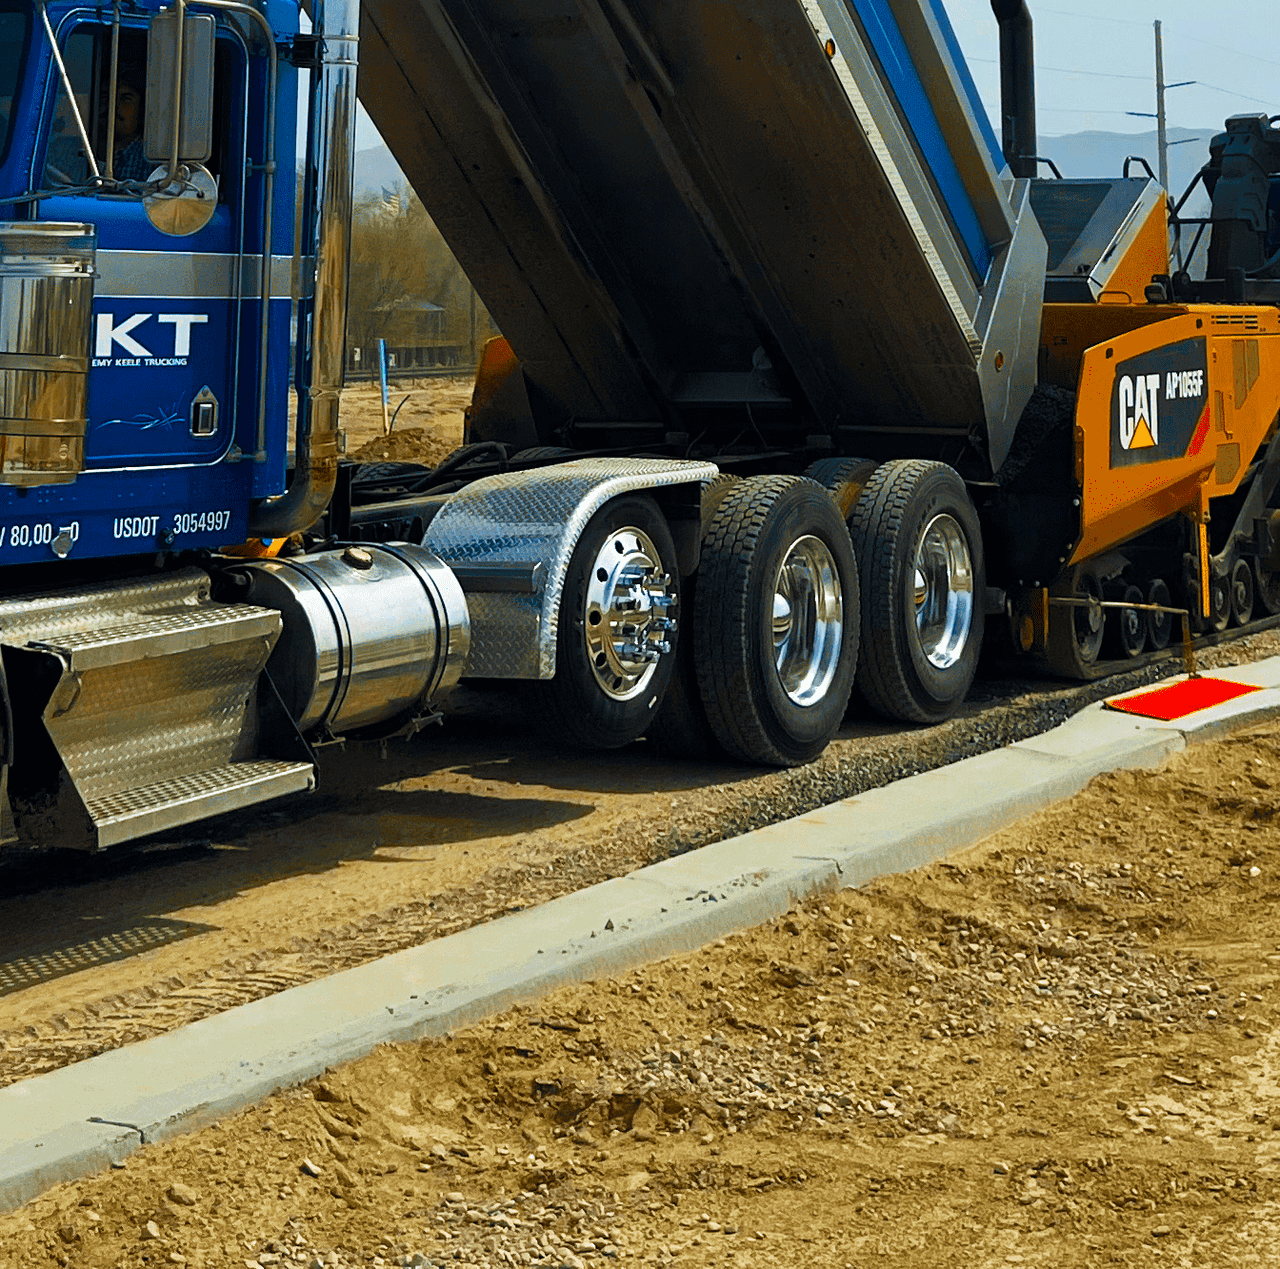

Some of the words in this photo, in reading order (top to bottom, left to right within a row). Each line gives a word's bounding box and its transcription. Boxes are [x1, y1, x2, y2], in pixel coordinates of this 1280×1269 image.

[94, 313, 209, 357] KT
[91, 358, 113, 367] EMY
[115, 358, 141, 366] KEELE
[144, 358, 187, 366] TRUCKING
[1165, 369, 1204, 400] AP1055F
[1119, 373, 1160, 450] CAT
[113, 515, 160, 539] USDOT
[173, 510, 231, 534] 3054997
